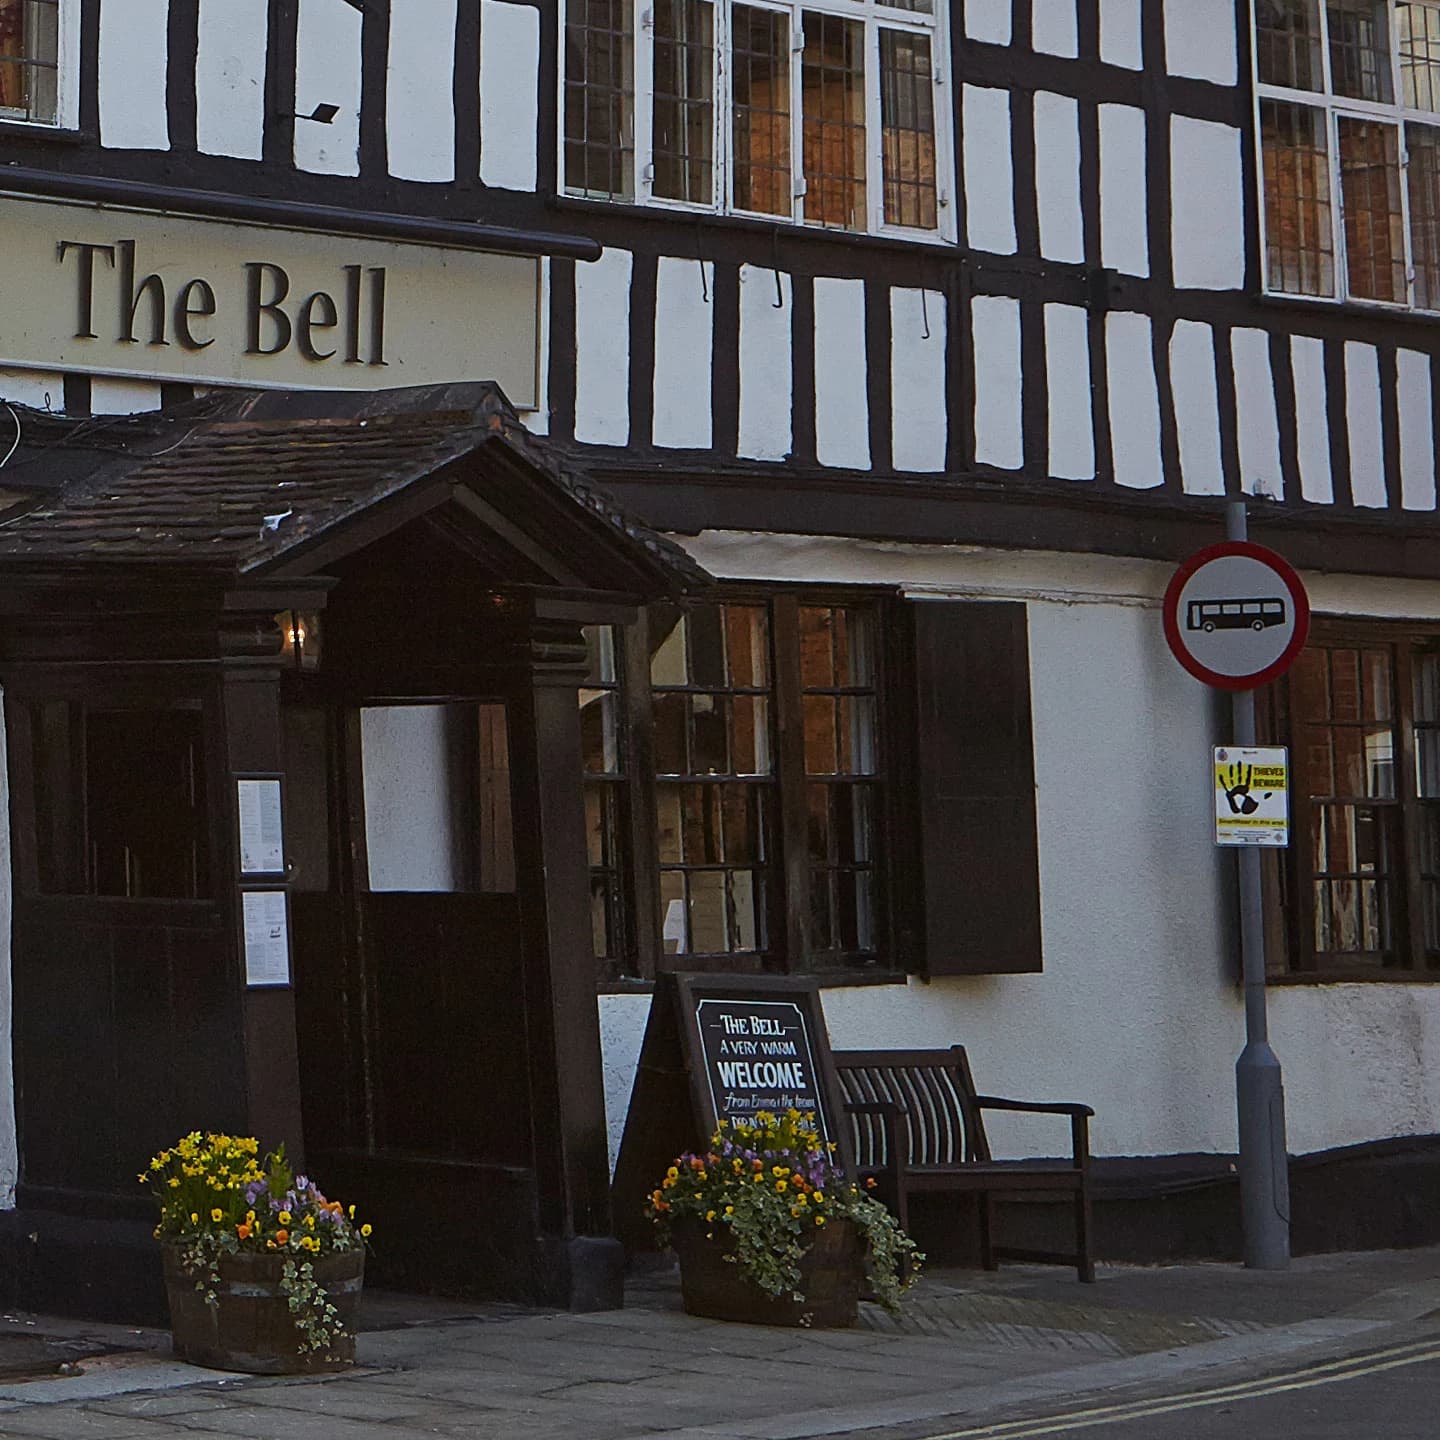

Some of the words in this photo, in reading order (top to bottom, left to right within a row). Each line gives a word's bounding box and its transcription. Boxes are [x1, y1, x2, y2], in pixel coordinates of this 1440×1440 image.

[56, 239, 216, 350] The
[244, 261, 389, 367] Bell
[720, 1039, 729, 1054] A
[730, 1041, 758, 1055] VERY
[761, 1041, 797, 1055] WARM
[717, 1061, 806, 1089] WELCOME
[723, 1091, 750, 1111] from
